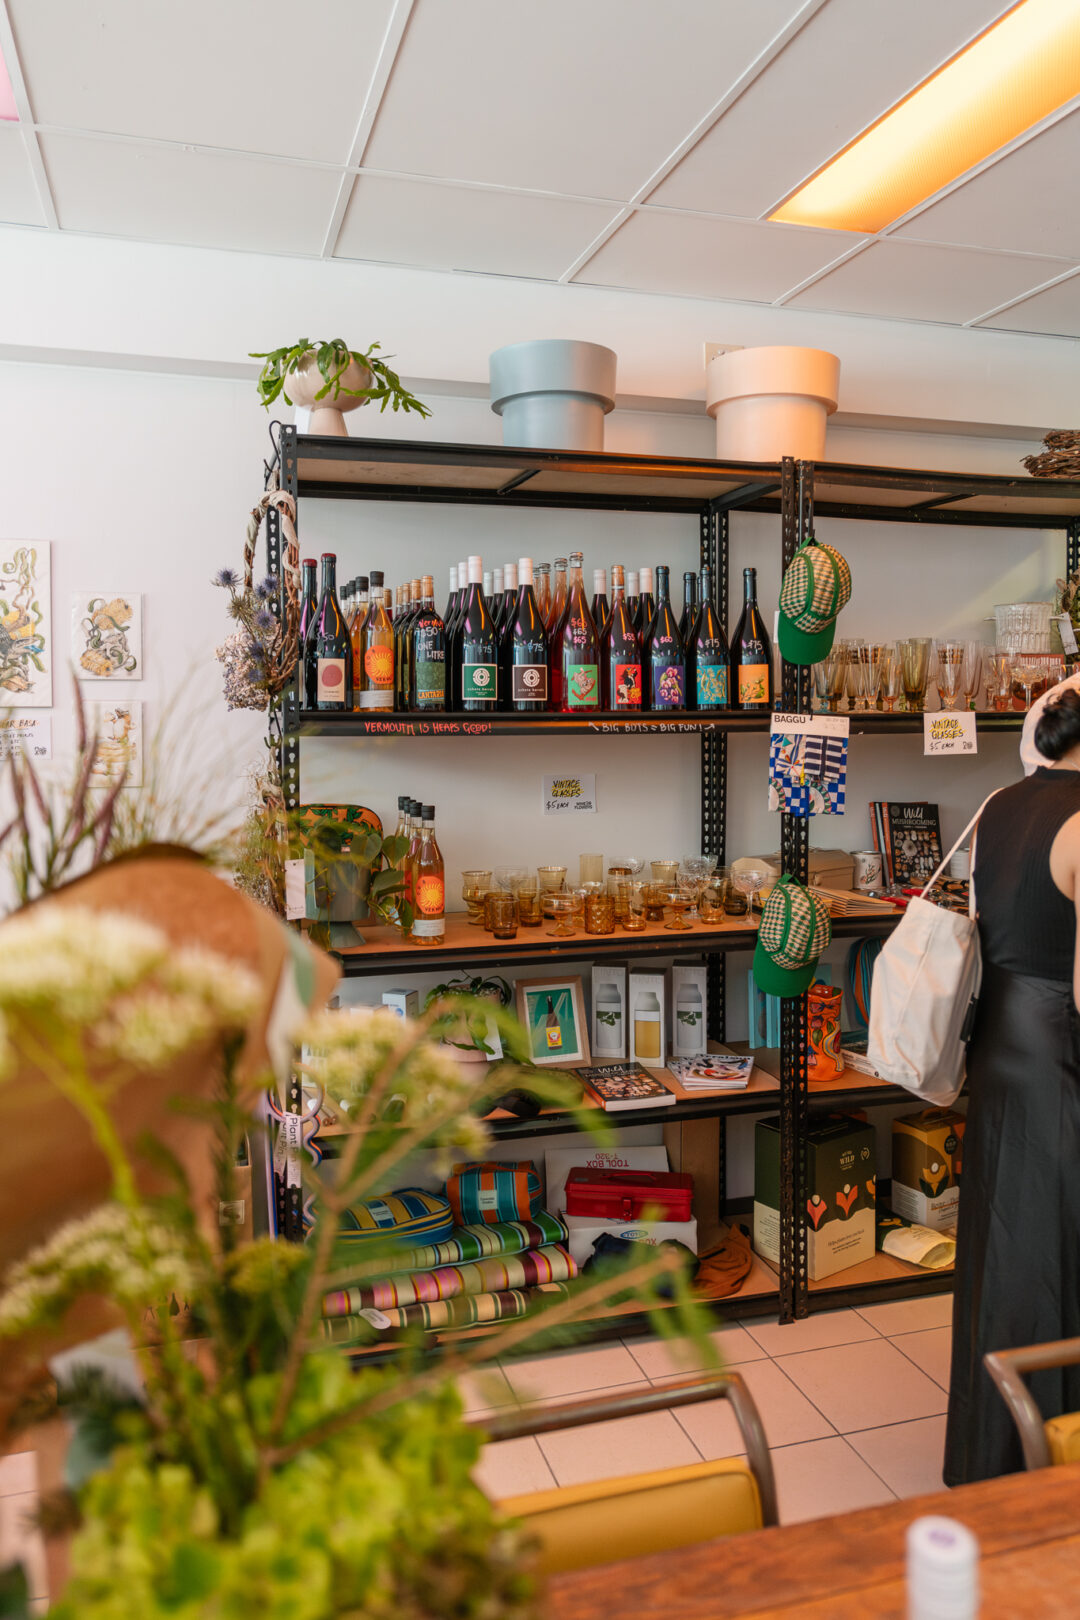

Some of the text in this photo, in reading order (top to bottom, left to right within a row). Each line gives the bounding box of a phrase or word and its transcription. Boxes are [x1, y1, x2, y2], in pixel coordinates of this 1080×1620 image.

[418, 641, 433, 651] ONE
[528, 642, 544, 652] $75
[774, 715, 806, 724] BAGGU
[931, 719, 959, 729] VINTAGE
[364, 722, 415, 736] VERMOUTH
[420, 722, 430, 734] IS
[433, 722, 460, 734] HEAPS
[602, 723, 619, 732] BIG
[625, 722, 648, 732] BOTS
[660, 723, 676, 732] BIG
[931, 729, 964, 740] GLASSES
[553, 780, 580, 788] VINTAGE
[552, 789, 581, 797] GLASSES
[546, 800, 557, 810] $5
[903, 807, 924, 819] Wild
[289, 1117, 298, 1145] Plant
[586, 1160, 604, 1168] BOX
